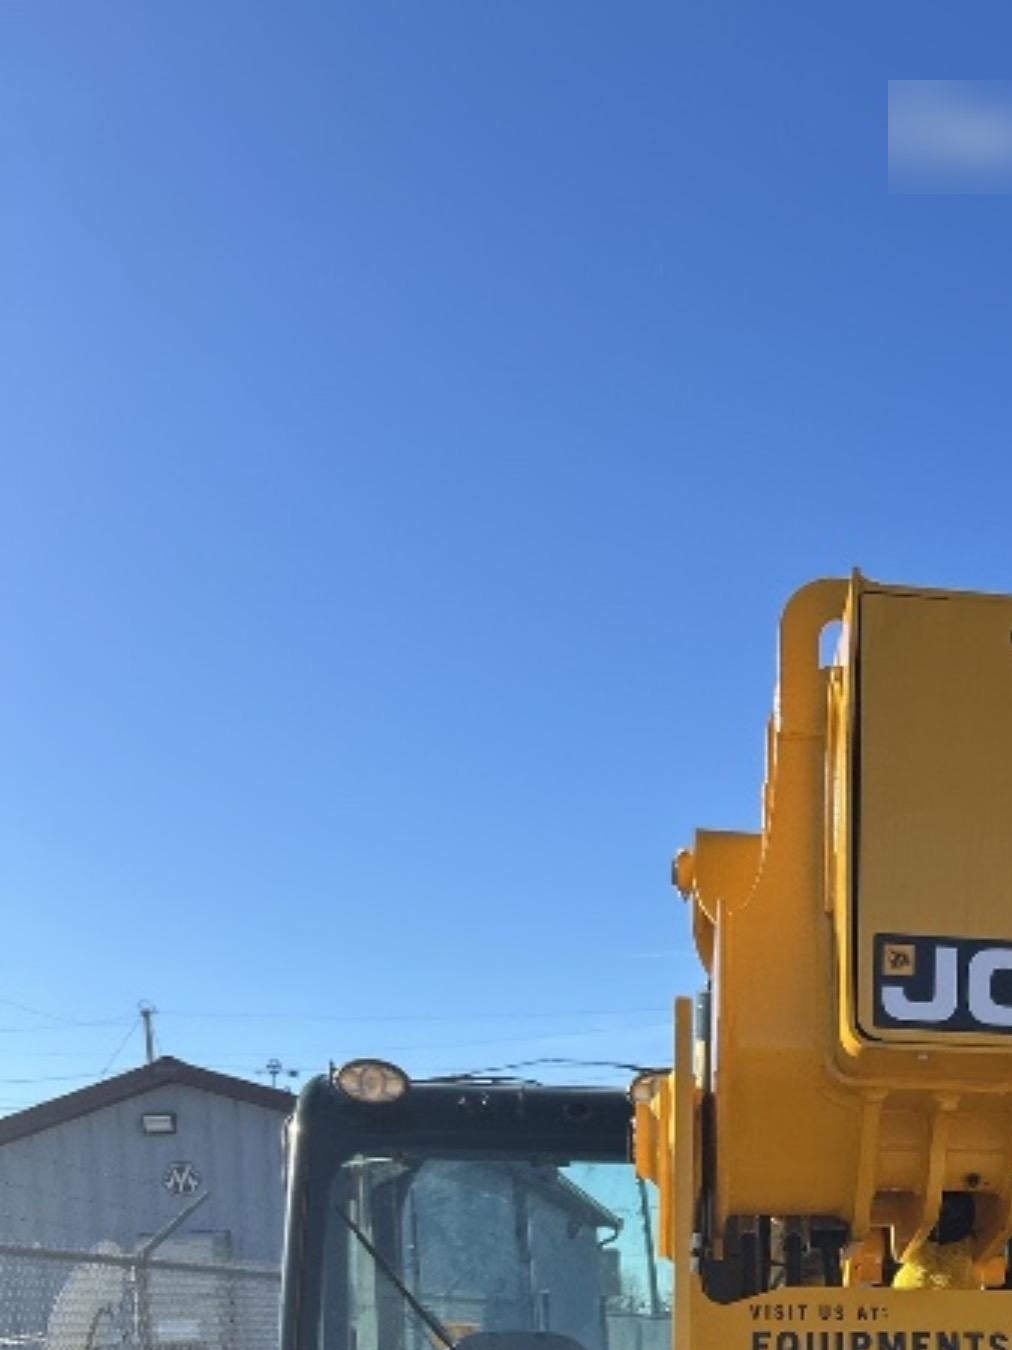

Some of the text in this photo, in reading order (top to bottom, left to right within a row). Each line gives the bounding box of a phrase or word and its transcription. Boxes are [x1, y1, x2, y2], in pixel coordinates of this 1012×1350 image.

[750, 1304, 888, 1321] VISIT US AT:
